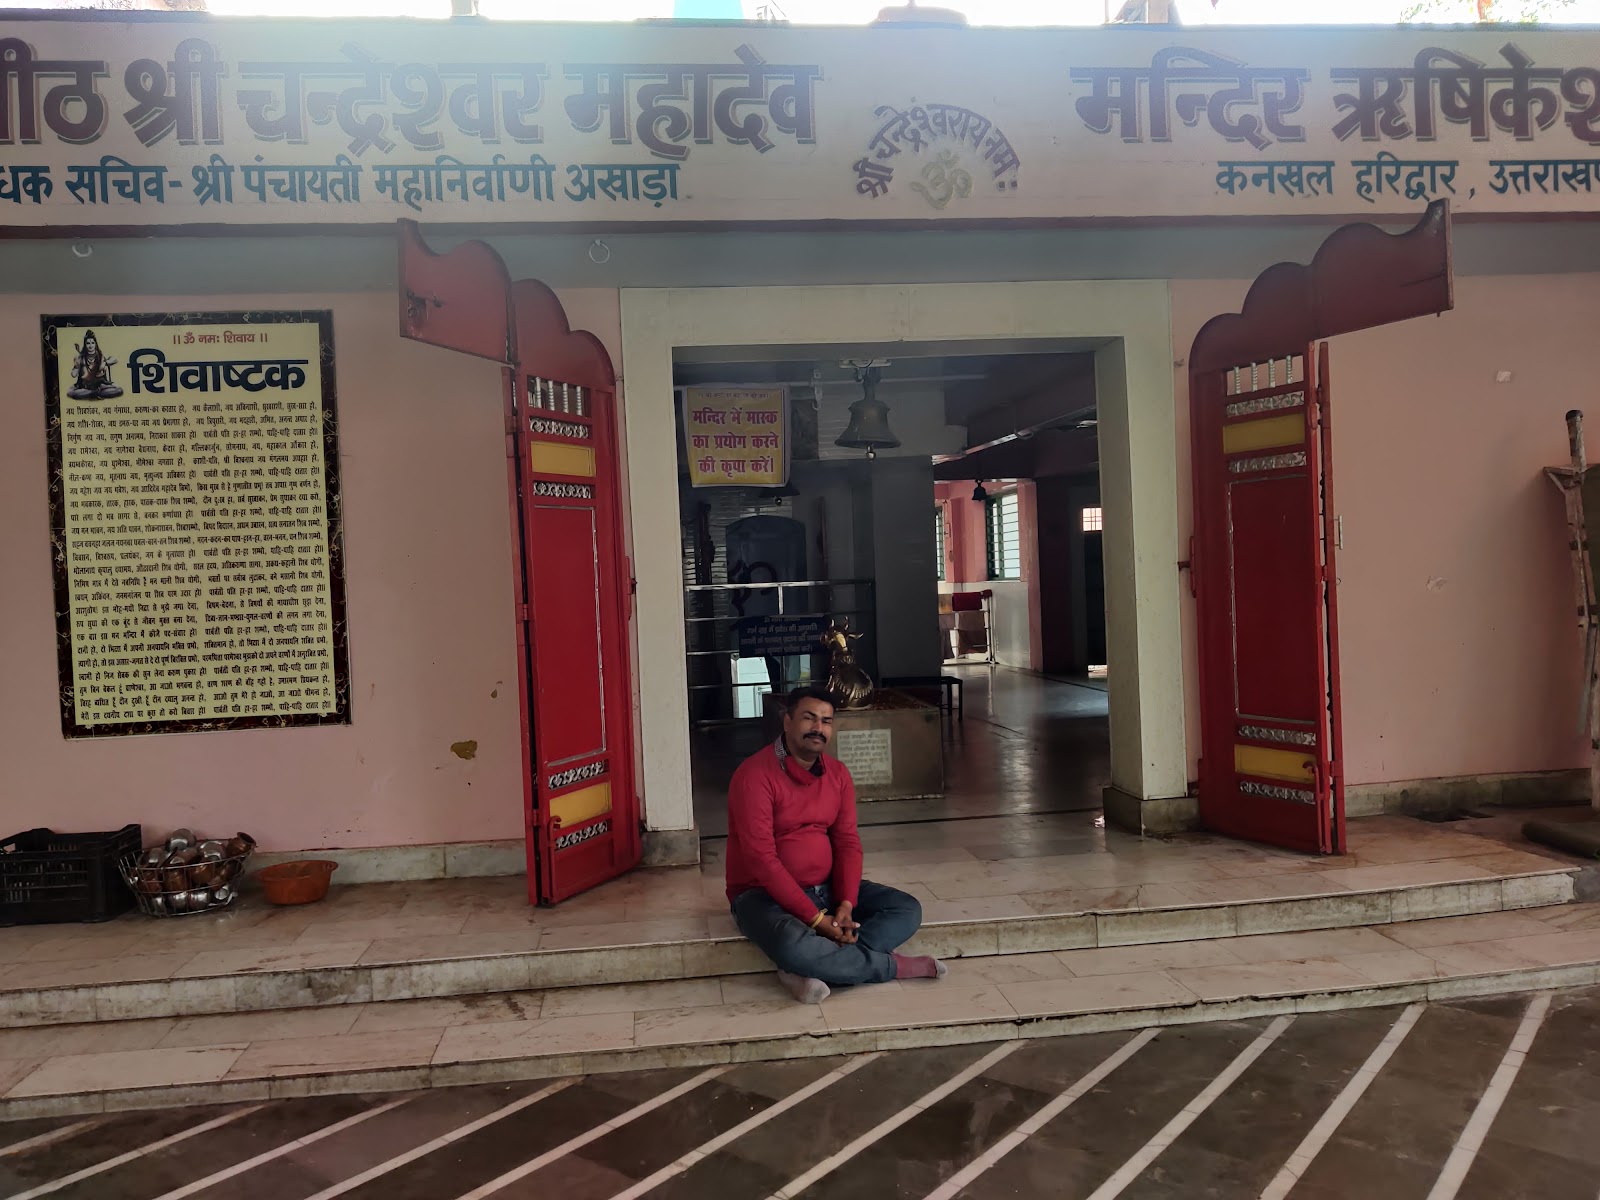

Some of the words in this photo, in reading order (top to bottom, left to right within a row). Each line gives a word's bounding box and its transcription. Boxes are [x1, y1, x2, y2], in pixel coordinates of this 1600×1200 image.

[123, 38, 229, 148] श्री
[236, 40, 550, 158] चन्द्रेश्वर
[563, 43, 824, 161] महादेव
[1070, 46, 1311, 151] मन्दिर
[192, 154, 235, 205] श्री
[240, 154, 363, 203] पंचायती
[372, 154, 556, 212] महानिर्वाणी
[564, 163, 681, 208] अखाड़ा
[1216, 161, 1335, 196] कनखल
[223, 330, 255, 344] शिवाय
[127, 348, 308, 393] शिवाष्टक
[692, 407, 726, 424] मन्दिर
[730, 407, 742, 424] में
[745, 411, 778, 424] मास्क
[692, 434, 709, 448] का
[714, 432, 747, 449] प्रयोग
[751, 432, 779, 448] करने
[697, 456, 716, 472] की
[720, 459, 746, 477] कृपा
